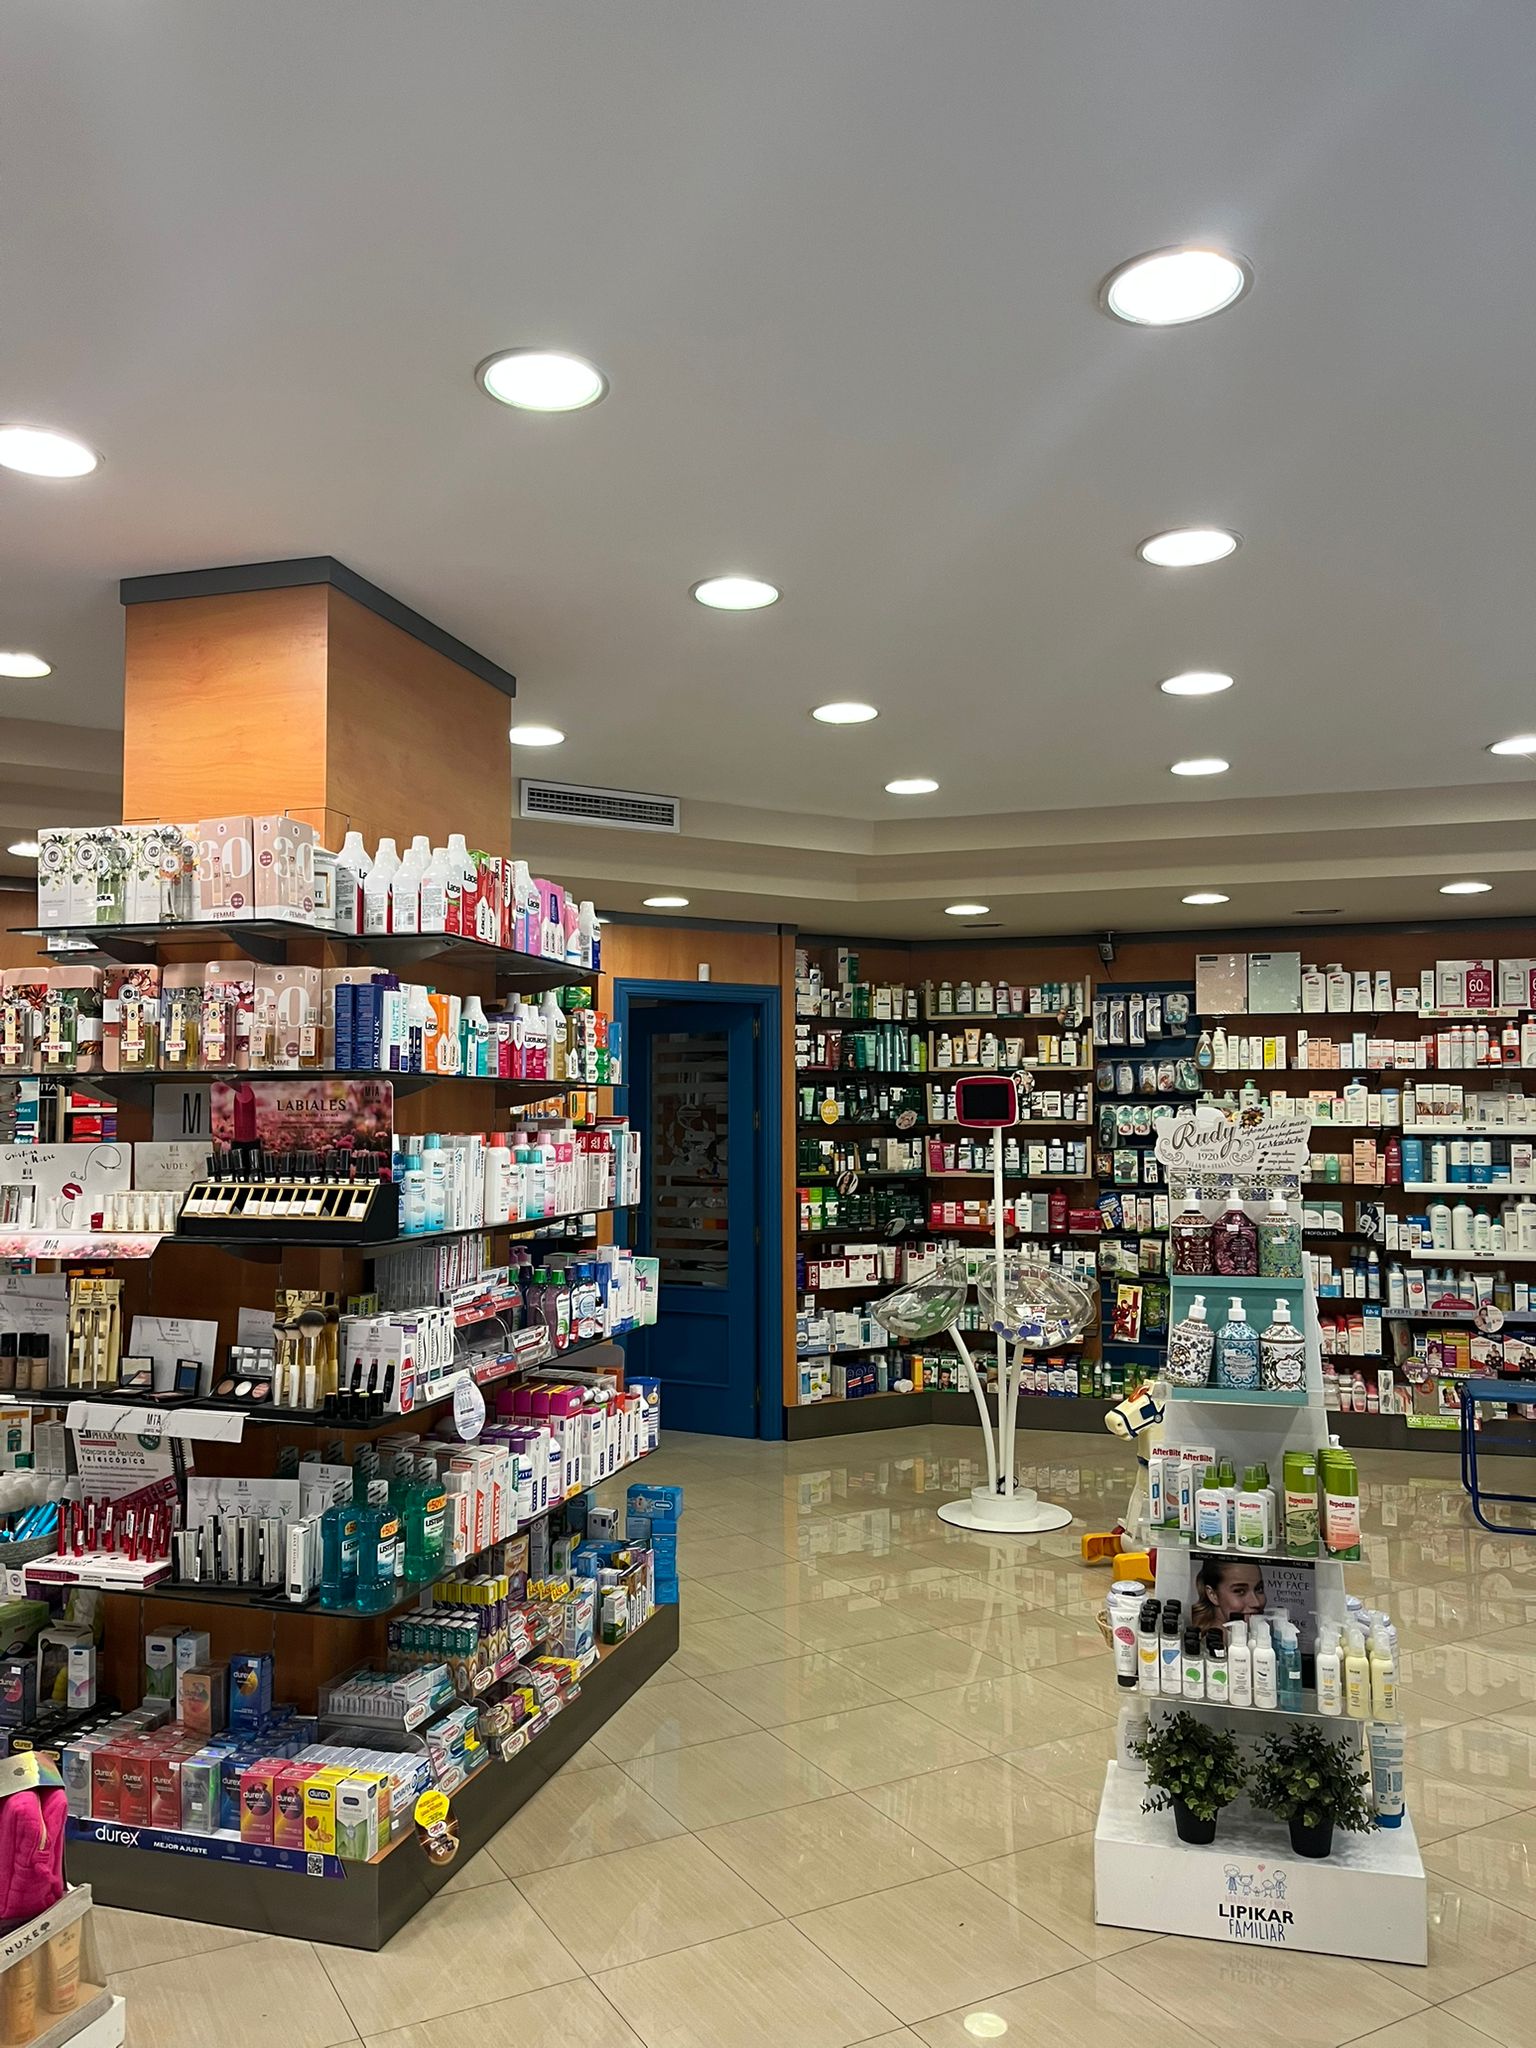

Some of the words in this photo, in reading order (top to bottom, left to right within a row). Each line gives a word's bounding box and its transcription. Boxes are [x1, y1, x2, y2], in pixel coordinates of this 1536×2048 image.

[199, 837, 252, 881] 30
[273, 837, 314, 882] 30
[213, 911, 236, 919] FEMME
[277, 1100, 346, 1112] LABIALES
[1172, 1120, 1241, 1158] Rudy
[1257, 1141, 1266, 1150] Le
[1197, 1152, 1218, 1161] 1920
[92, 1431, 127, 1441] PHARMA
[1152, 1448, 1181, 1456] AfterBite
[82, 1455, 146, 1465] telescópica
[1183, 1453, 1213, 1462] AfterBite
[493, 1488, 501, 1541] elmex
[476, 1495, 484, 1548] elmex
[1278, 1571, 1304, 1580] LOVE
[1267, 1579, 1284, 1588] MY
[1286, 1581, 1310, 1591] FACE
[1276, 1589, 1302, 1597] perfect
[94, 1769, 114, 1778] durex
[122, 1773, 142, 1782] durex
[152, 1776, 172, 1785] durex
[243, 1791, 264, 1800] durex
[276, 1794, 296, 1803] durex
[309, 1790, 330, 1799] durex
[95, 1825, 140, 1848] durex
[153, 1842, 180, 1851] MEJOR
[181, 1845, 208, 1854] AJUSTE
[1219, 1904, 1294, 1925] LIPIKAR
[1229, 1919, 1286, 1942] FAMILIAR
[5, 1930, 40, 1956] NUXE
